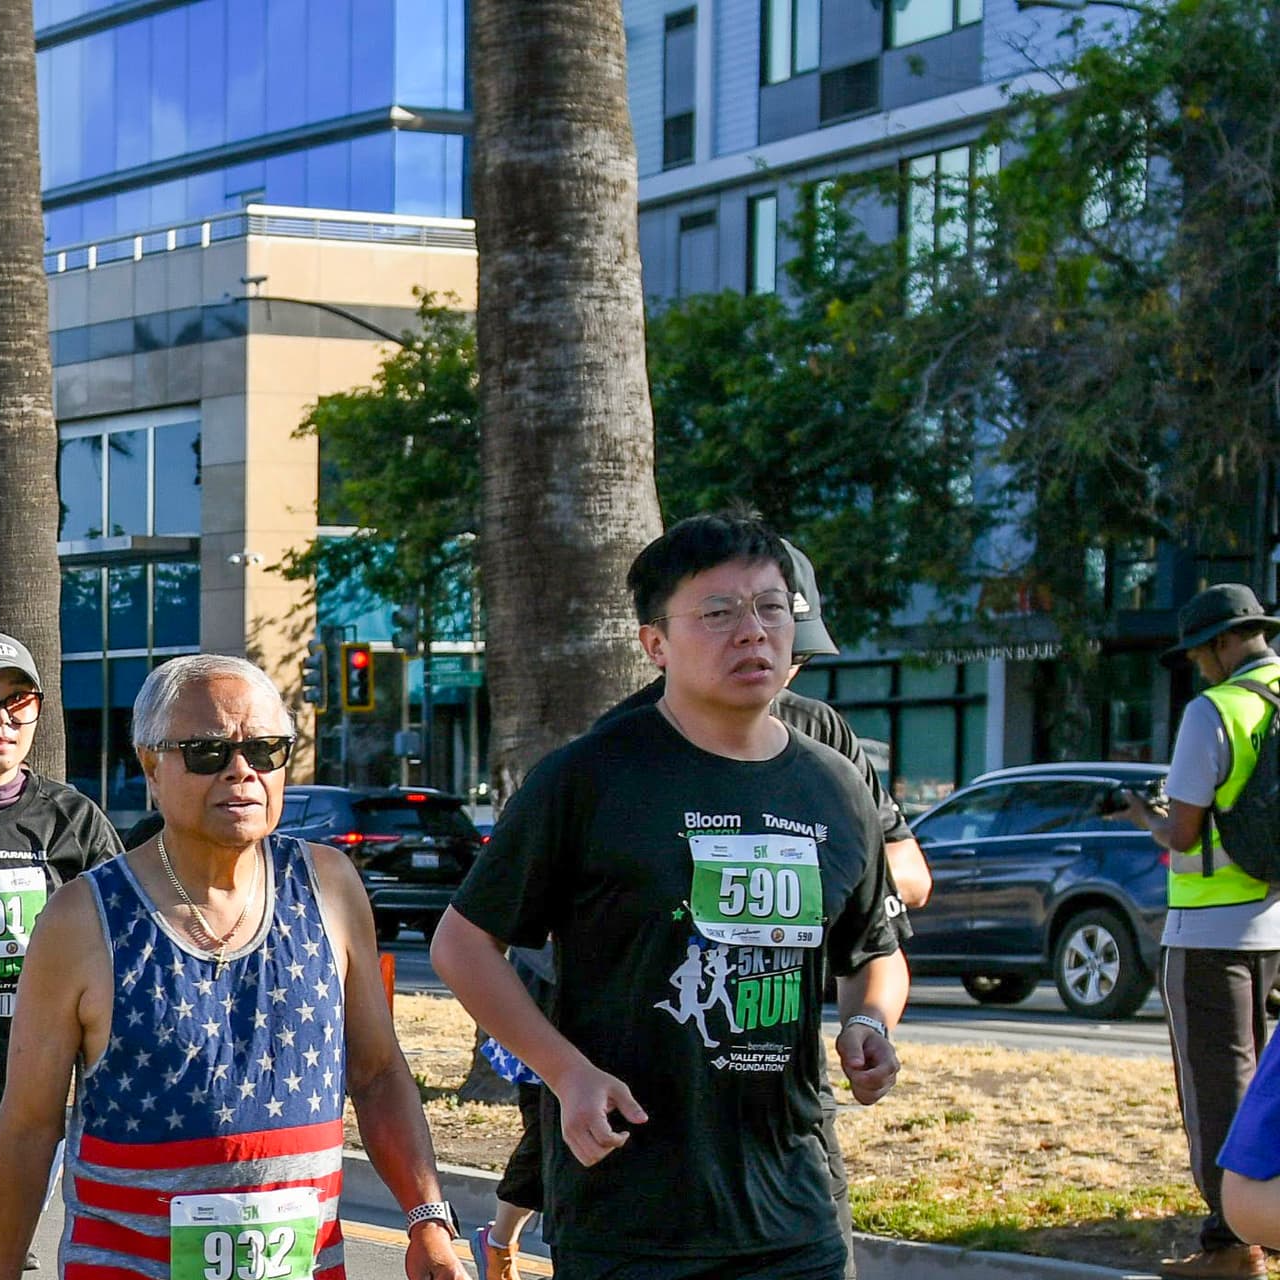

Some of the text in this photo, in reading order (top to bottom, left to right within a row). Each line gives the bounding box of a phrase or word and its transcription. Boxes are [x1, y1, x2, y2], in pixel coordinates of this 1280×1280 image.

[684, 812, 814, 837] Bloom TARANA
[754, 845, 768, 859] 5K
[718, 867, 800, 918] 590
[797, 931, 813, 942] 590
[736, 970, 802, 1030] RUN
[730, 1053, 790, 1062] VALLEY HEALT
[728, 1062, 785, 1072] FOUNDATION
[242, 1205, 259, 1221] 5K
